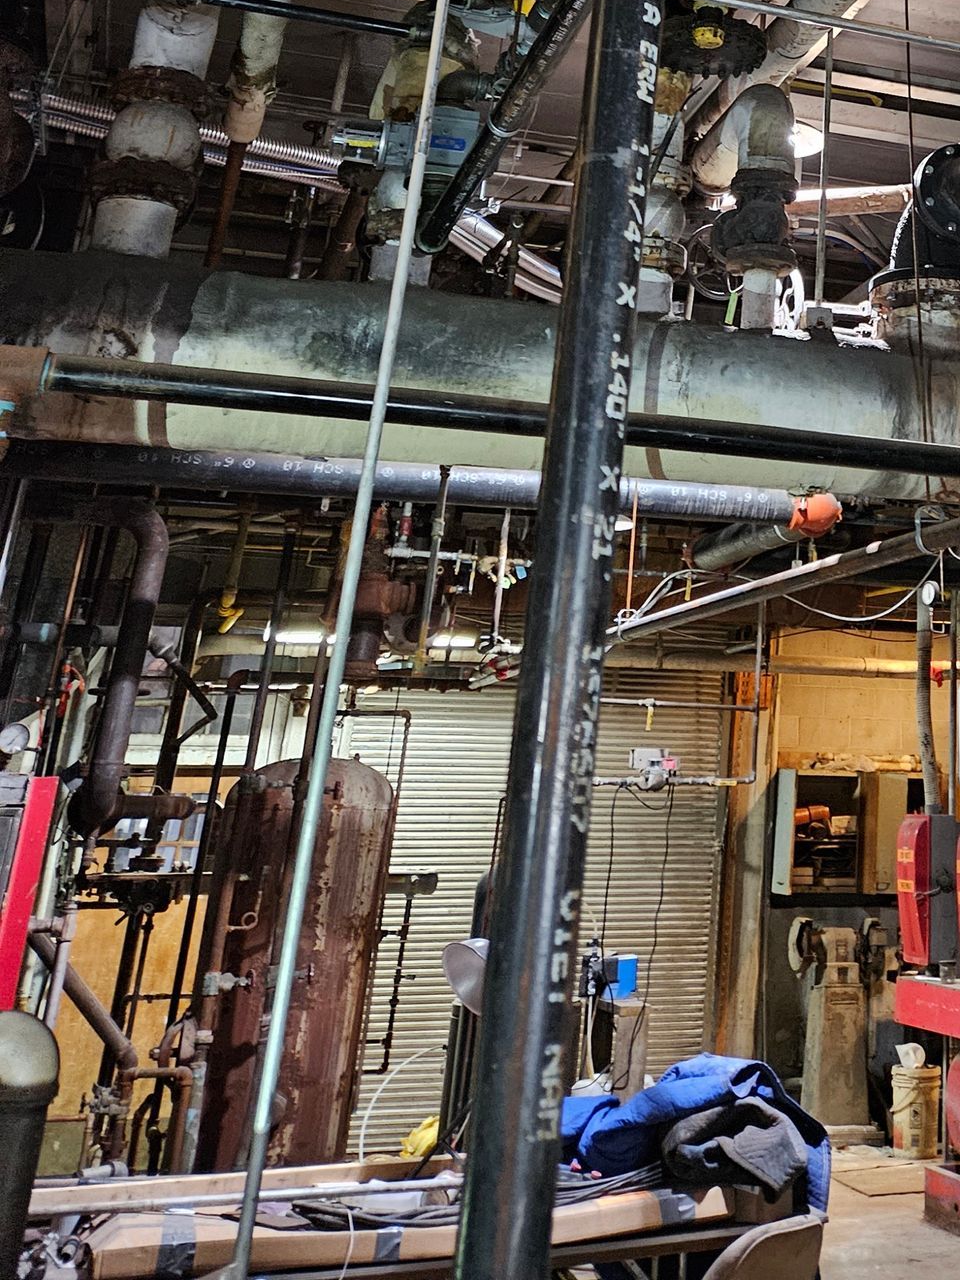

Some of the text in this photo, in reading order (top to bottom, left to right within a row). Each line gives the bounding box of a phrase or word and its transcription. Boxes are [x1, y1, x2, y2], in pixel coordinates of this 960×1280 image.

[636, 39, 659, 105] ERW
[615, 281, 637, 309] X
[170, 453, 202, 466] SCH
[313, 463, 344, 475] SCH
[599, 464, 620, 492] X
[698, 488, 728, 501] SCH
